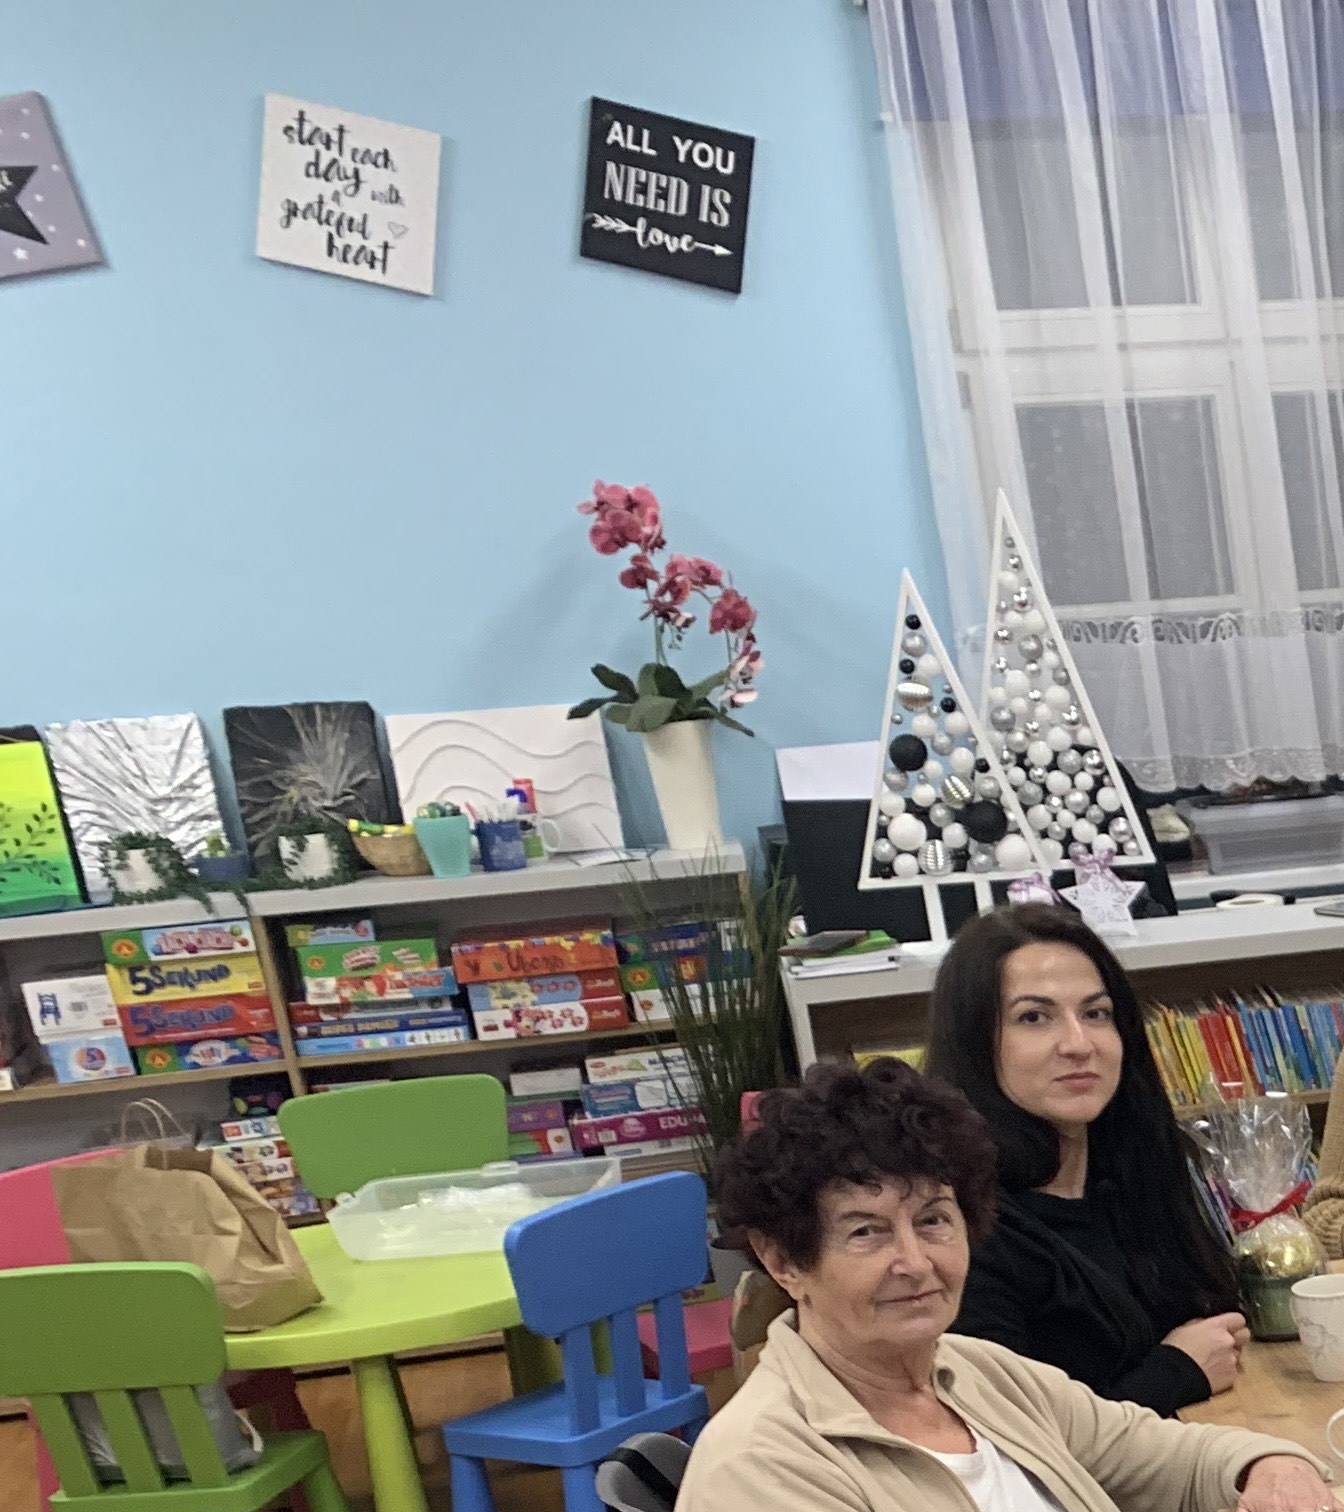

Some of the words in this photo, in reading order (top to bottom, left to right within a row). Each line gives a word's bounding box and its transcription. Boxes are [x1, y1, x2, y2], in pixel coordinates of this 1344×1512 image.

[283, 109, 350, 157] start
[606, 120, 657, 156] ALL
[672, 135, 735, 175] YOU
[304, 149, 367, 198] day
[603, 160, 689, 217] NEED
[698, 184, 732, 227] IS
[326, 231, 396, 275] heart
[636, 216, 696, 253] love
